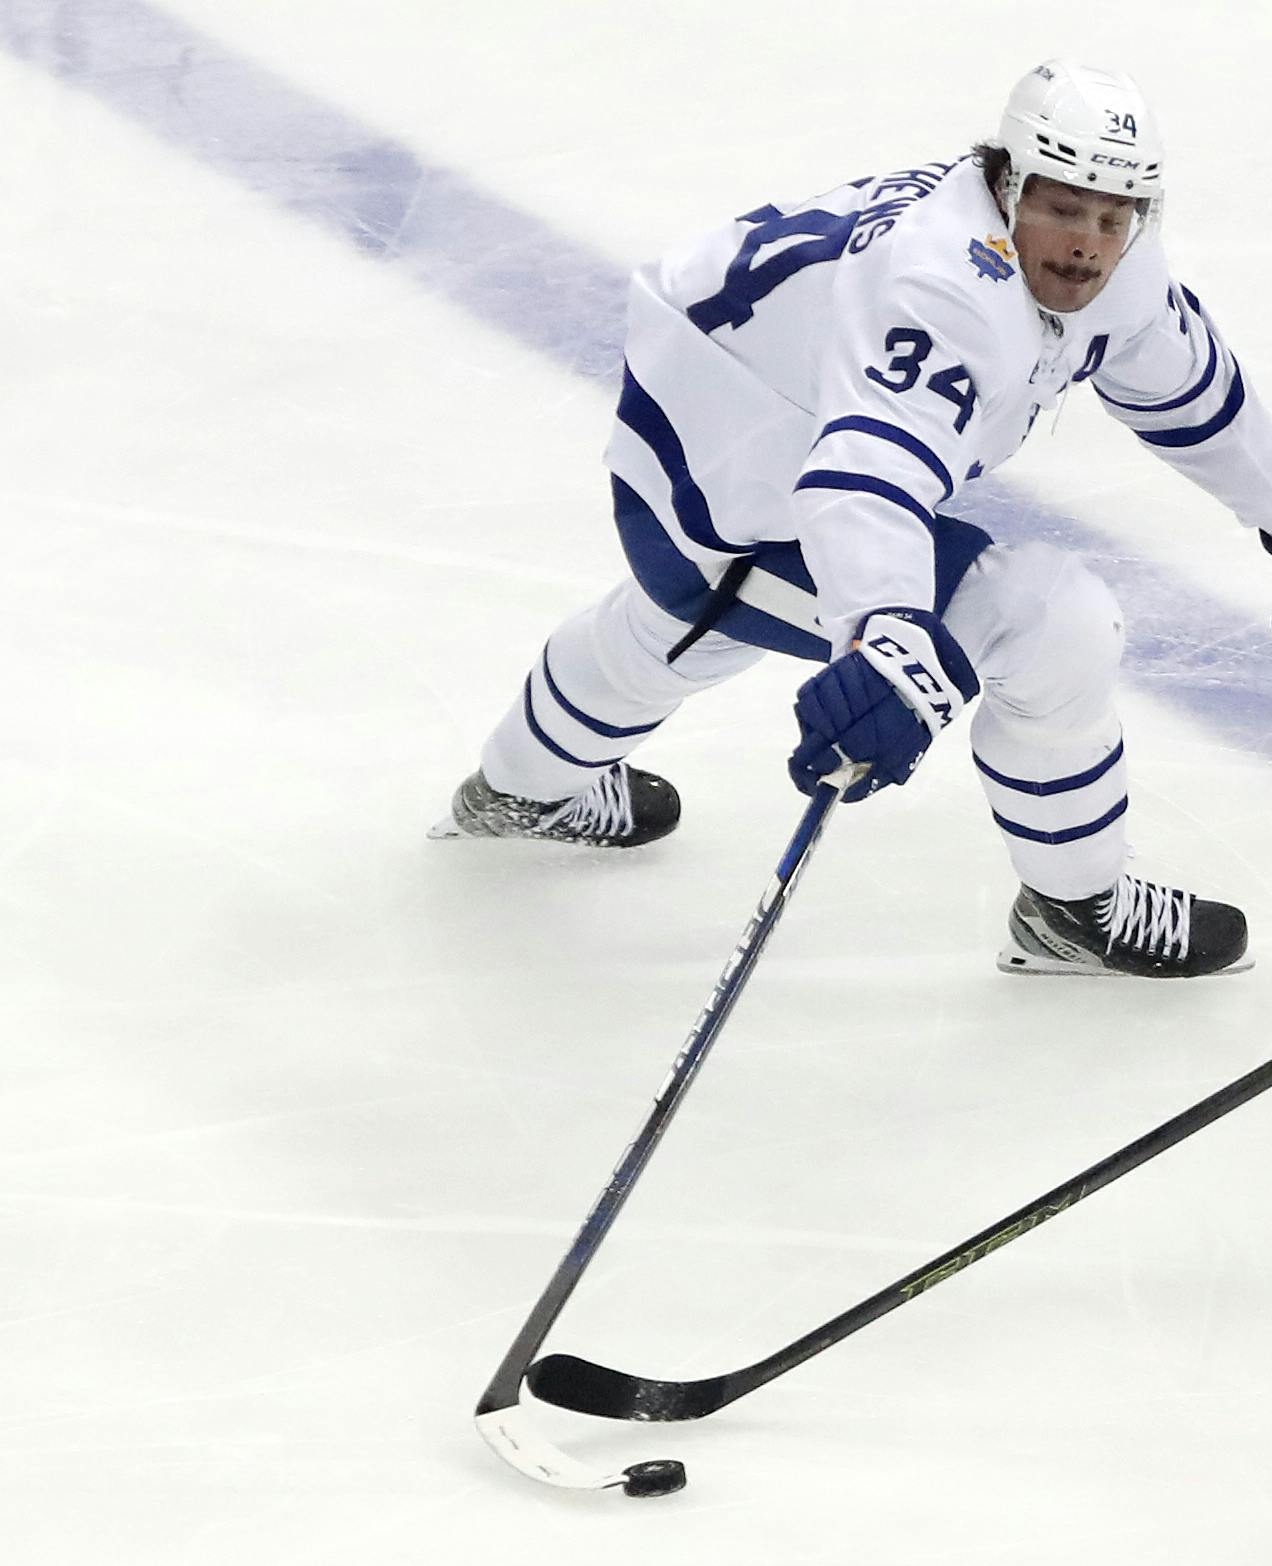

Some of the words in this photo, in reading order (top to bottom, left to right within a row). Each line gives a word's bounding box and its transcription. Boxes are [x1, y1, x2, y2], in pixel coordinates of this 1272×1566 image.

[1090, 152, 1141, 171] CCM
[1103, 109, 1138, 139] 34
[850, 153, 973, 254] THEWS
[864, 326, 978, 435] 34
[867, 633, 953, 730] CCM
